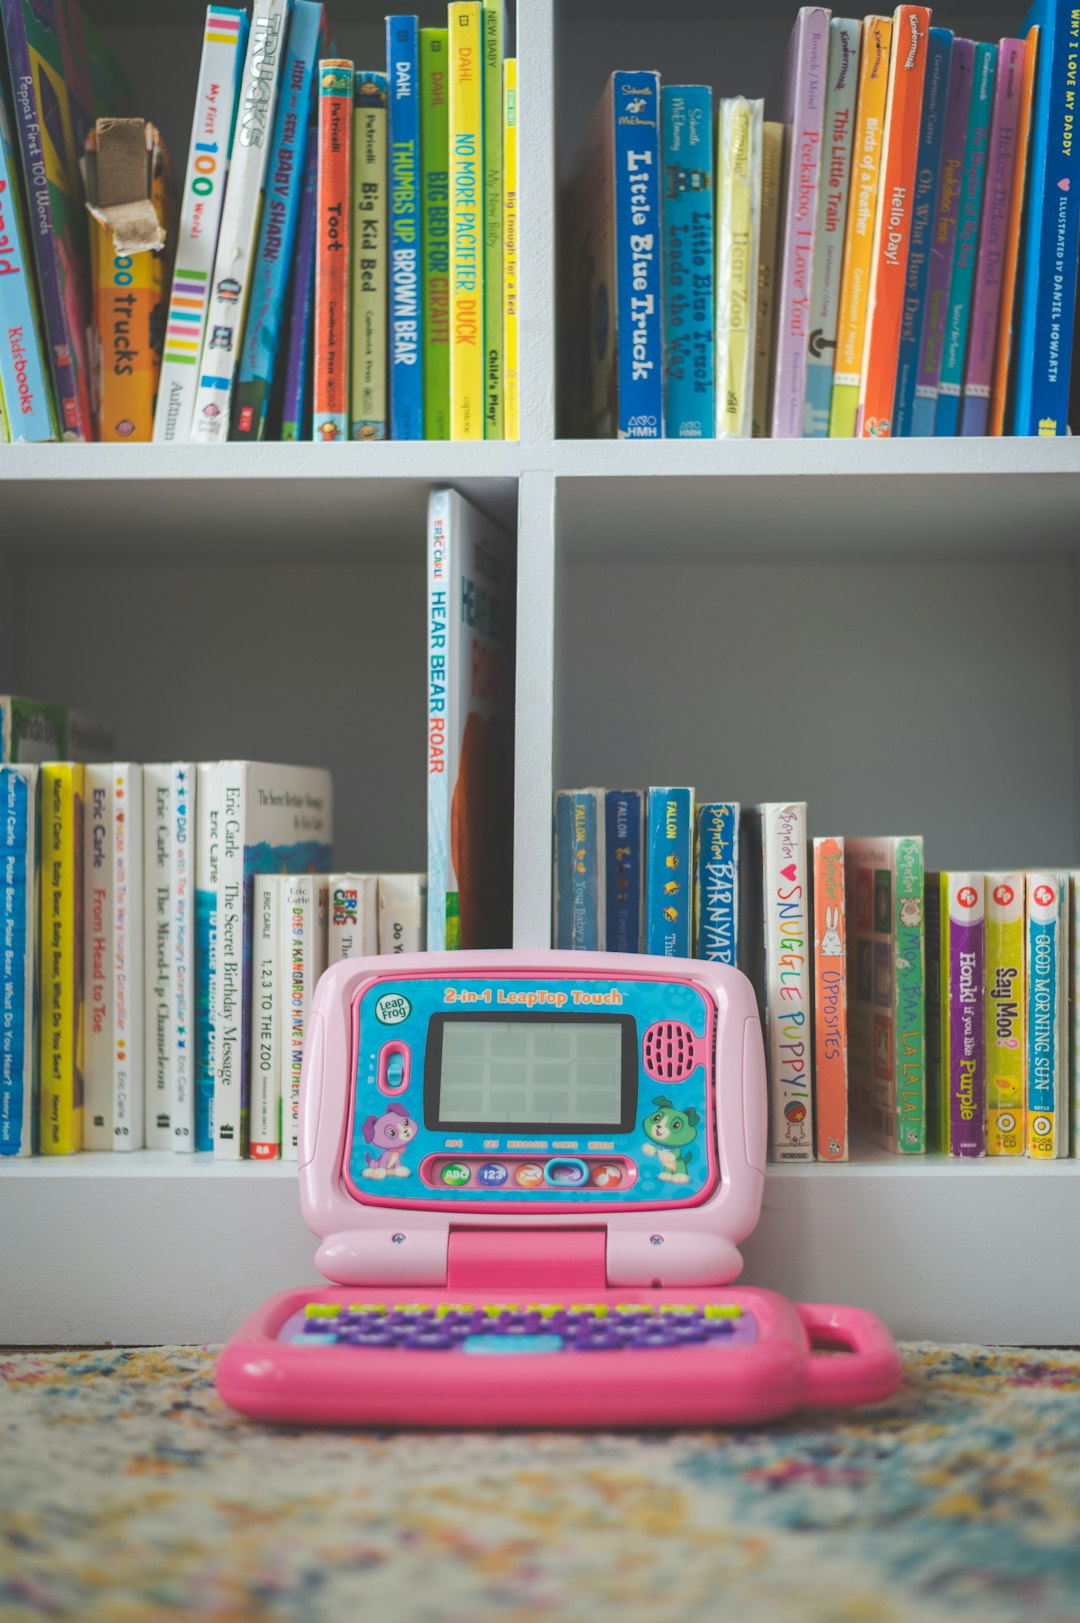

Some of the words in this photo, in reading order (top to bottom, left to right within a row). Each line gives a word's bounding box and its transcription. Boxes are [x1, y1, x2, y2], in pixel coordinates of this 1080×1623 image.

[487, 10, 497, 36] NEW
[1069, 9, 1080, 37] WHY
[487, 39, 498, 68] BABY
[904, 14, 922, 70] Kindermusik
[240, 14, 282, 148] TRUCKS
[395, 62, 411, 100] DAHL
[459, 47, 472, 84] DAHL
[1066, 54, 1077, 86] LOVE
[18, 75, 38, 120] Peppa's
[205, 84, 221, 102] My
[431, 72, 445, 108] DAHL
[1065, 91, 1076, 110] MY
[204, 107, 217, 134] First
[863, 118, 878, 151] Birds
[1062, 115, 1074, 156] DADDY
[26, 124, 42, 156] First
[365, 115, 377, 164] Patricelli
[455, 133, 476, 156] NO
[993, 127, 1013, 184] Hickory
[32, 161, 46, 186] 100
[191, 142, 218, 196] 100
[393, 140, 415, 214] THUMBS
[486, 170, 499, 188] My
[829, 146, 846, 187] Little
[861, 155, 876, 170] of
[359, 182, 379, 211] Big
[427, 171, 448, 201] BIG
[455, 161, 476, 208] MORE
[627, 150, 652, 226] Little
[35, 190, 52, 235] Words
[190, 203, 204, 240] Words
[428, 206, 449, 237] BED
[488, 193, 499, 217] New
[888, 187, 906, 230] Hello,
[988, 189, 1007, 245] Dickory
[328, 202, 343, 252] Toot
[362, 220, 378, 249] Kid
[486, 222, 500, 248] Baby
[692, 212, 711, 266] Little
[1056, 197, 1067, 258] ILLUSTRATED
[428, 241, 449, 273] FOR
[630, 234, 654, 291] Blue
[670, 225, 689, 286] Leads
[884, 233, 902, 265] Day!
[361, 258, 377, 292] Bed
[984, 250, 1001, 287] Dock
[1055, 260, 1064, 272] BY
[393, 249, 417, 317] BROWN
[692, 274, 711, 322] Blue
[1052, 275, 1063, 320] DANIEL
[429, 277, 449, 346] GIRAFFE
[456, 299, 477, 346] DUCK
[670, 294, 690, 326] the
[394, 320, 417, 365] BEAR
[631, 294, 654, 380] Truck
[1048, 323, 1060, 382] HOWARTH
[8, 326, 34, 415] Kidsbooks
[488, 349, 499, 390] Child's
[667, 334, 690, 380] Way
[693, 330, 712, 393] Truck
[628, 426, 657, 437] HMH
[433, 520, 445, 548] ERIC
[433, 549, 443, 579] CARLE
[431, 592, 446, 648] HEAR
[430, 655, 446, 713] BEAR
[430, 718, 445, 773] ROAR
[93, 788, 106, 820] Eric
[157, 787, 170, 819] Eric
[225, 787, 240, 816] Eric
[7, 816, 17, 846] Carle
[177, 818, 187, 843] DAD
[575, 804, 586, 841] FALLON
[666, 801, 677, 839] FALLON
[707, 805, 729, 861] Boynton
[778, 812, 799, 859] Boynton
[93, 824, 106, 869] Carle
[157, 826, 170, 867] Carle
[225, 820, 240, 858] Carle
[6, 855, 15, 885] Polar
[822, 853, 842, 900] Boynton
[901, 843, 919, 893] Boynton
[157, 885, 170, 914] The
[178, 877, 186, 895] The
[225, 882, 239, 910] The
[263, 891, 271, 910] ERIC
[290, 887, 307, 896] Eric
[575, 880, 586, 906] Your
[93, 888, 107, 932] From
[292, 908, 304, 935] DOES
[333, 890, 345, 926] CARLE
[345, 890, 357, 925] ERIC
[5, 918, 14, 947] Polar
[224, 914, 238, 956] Secret
[262, 912, 271, 939] CARLE
[393, 923, 403, 939] Do
[574, 908, 586, 942] Baby's
[93, 937, 107, 979] Head
[154, 922, 170, 997] Mixed-Up
[664, 933, 676, 957] This
[777, 885, 804, 1001] SNUGGLE
[1035, 934, 1051, 975] GOOD
[94, 984, 105, 1001] to
[219, 962, 237, 1021] Birthday
[292, 948, 304, 1006] KANGAROO
[960, 952, 977, 1003] Honk!
[990, 968, 1018, 998] Say
[4, 982, 14, 1009] What
[261, 994, 273, 1010] TO
[380, 998, 404, 1011] Leap
[444, 988, 491, 1003] 2-in-1
[497, 989, 567, 1007] LeapTop
[571, 989, 623, 1005] Touch
[963, 1006, 974, 1016] if
[4, 1012, 13, 1027] Do
[93, 1003, 106, 1034] Toe
[260, 1015, 272, 1039] THE
[292, 1009, 303, 1037] HAVE
[382, 1006, 406, 1020] Frog
[822, 971, 844, 1060] OPPOSITES
[961, 1016, 973, 1035] you
[995, 1002, 1019, 1049] Moo?
[1034, 978, 1050, 1055] MORNING,
[3, 1031, 13, 1051] You
[157, 1003, 171, 1090] Chameleon
[217, 1026, 237, 1086] Message
[260, 1044, 272, 1071] ZOO
[778, 1011, 809, 1098] PUPPY!
[902, 1031, 921, 1056] LA
[963, 1036, 975, 1056] like
[4, 1054, 13, 1085] Hear?
[902, 1062, 922, 1085] LA
[1034, 1057, 1049, 1090] SUN
[1, 1092, 11, 1118] Henry
[955, 1059, 978, 1120] Purple
[2, 1121, 11, 1141] Holt
[445, 1139, 463, 1148] ABC
[483, 1139, 500, 1148] 123
[588, 1141, 615, 1150] MUSIC
[483, 1169, 504, 1179] 123
